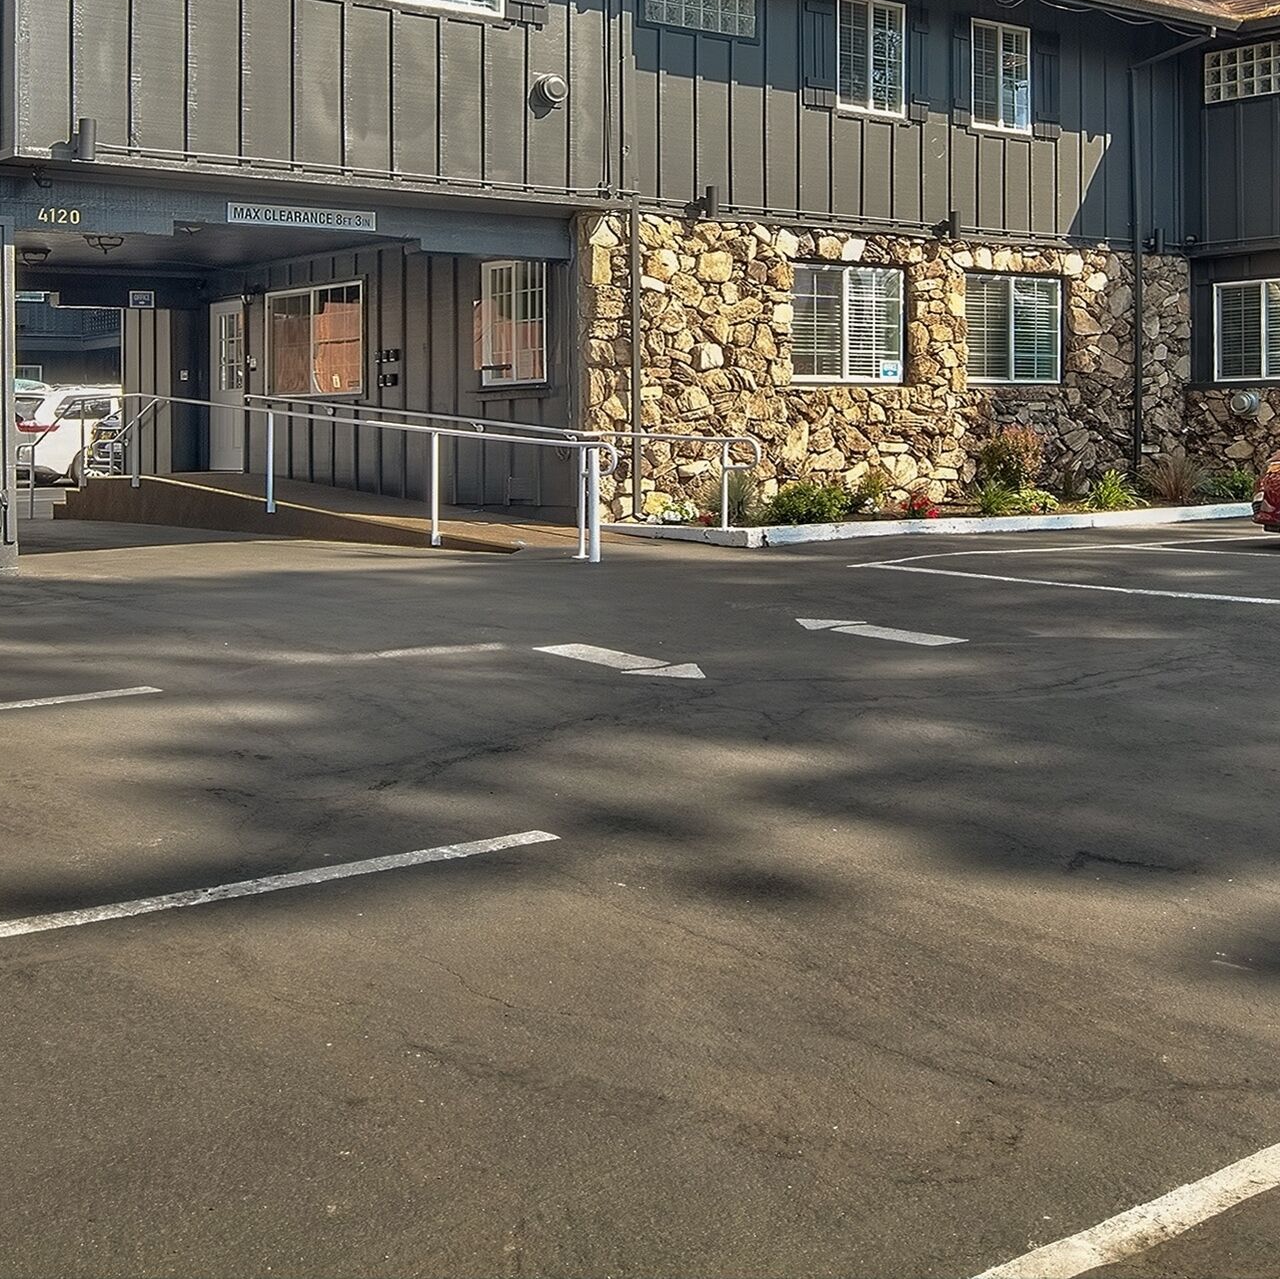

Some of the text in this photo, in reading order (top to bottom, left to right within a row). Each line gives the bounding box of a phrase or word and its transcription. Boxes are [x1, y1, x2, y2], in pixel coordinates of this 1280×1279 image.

[38, 208, 80, 224] 4120
[233, 207, 261, 220] MAX
[264, 208, 332, 224] CLEARANCE
